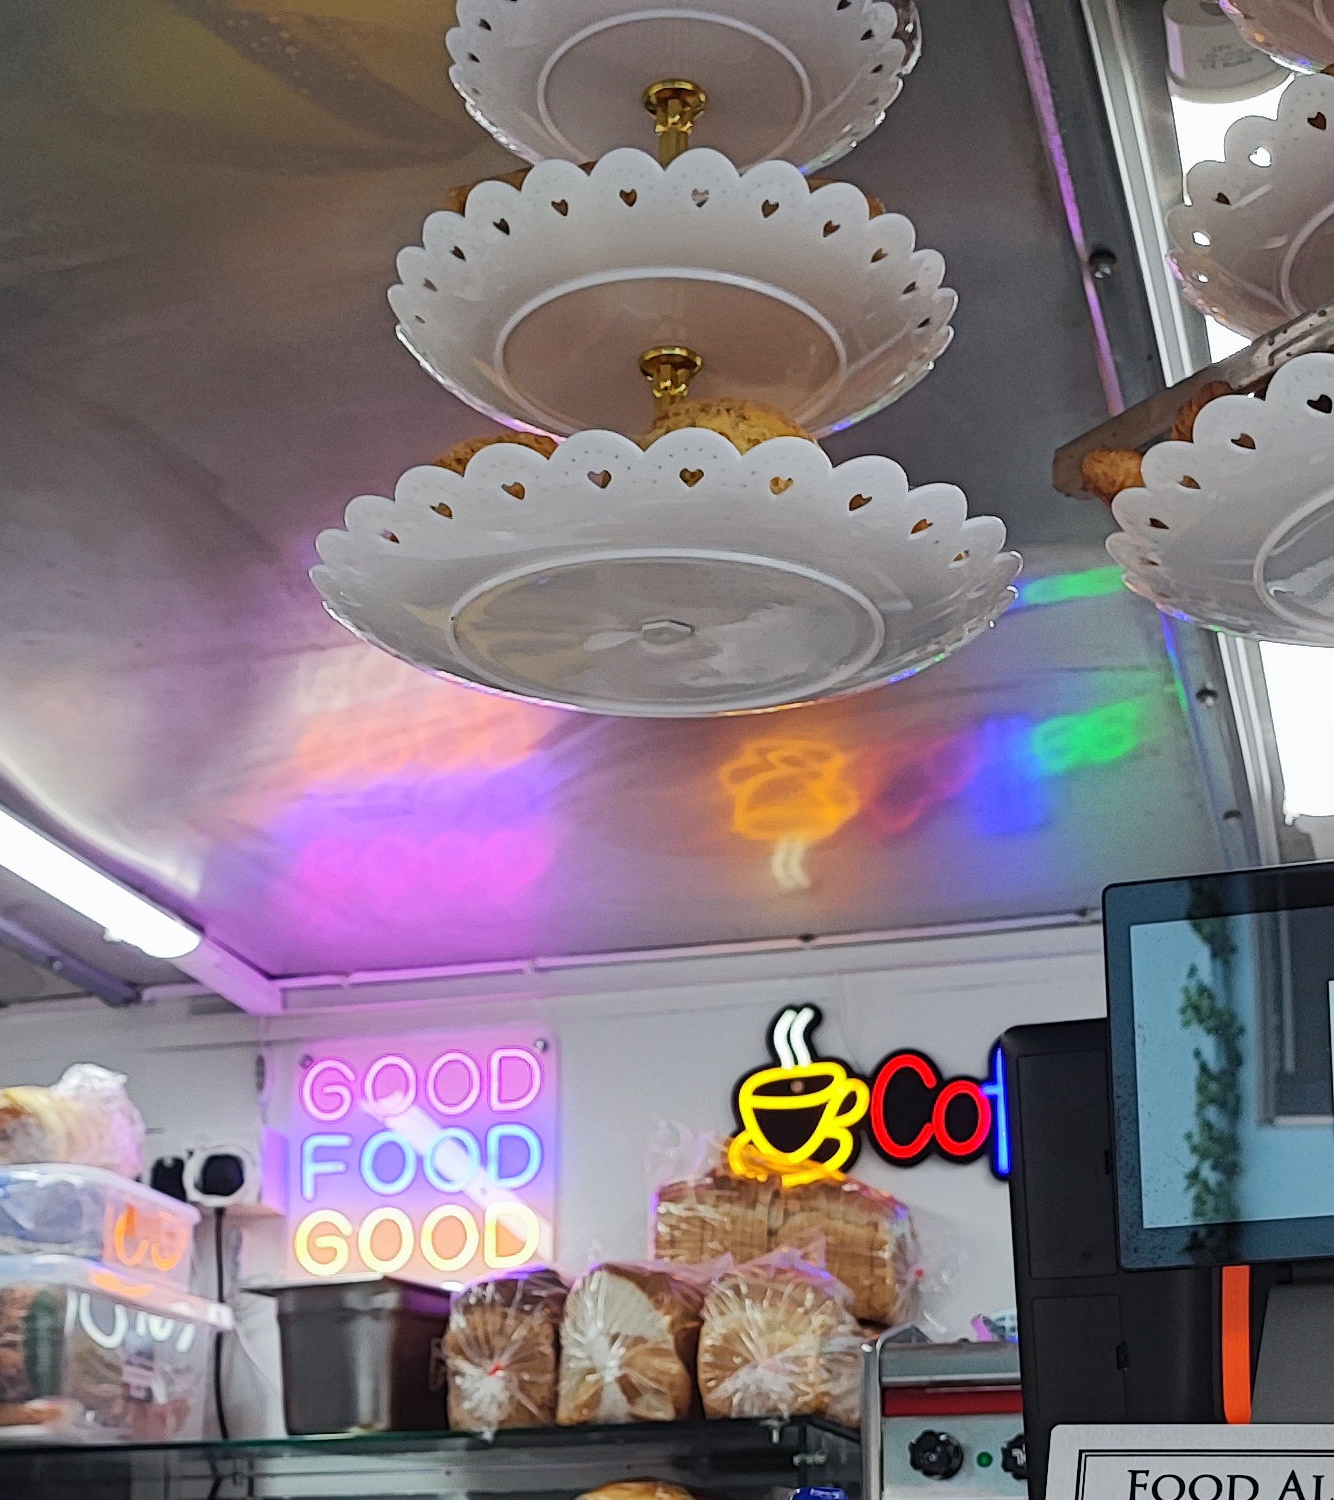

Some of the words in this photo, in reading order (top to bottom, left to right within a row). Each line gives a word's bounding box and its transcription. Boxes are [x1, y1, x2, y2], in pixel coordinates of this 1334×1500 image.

[301, 1048, 543, 1121] GOOD
[301, 1125, 543, 1200] FOOD
[294, 1204, 542, 1276] GOOD
